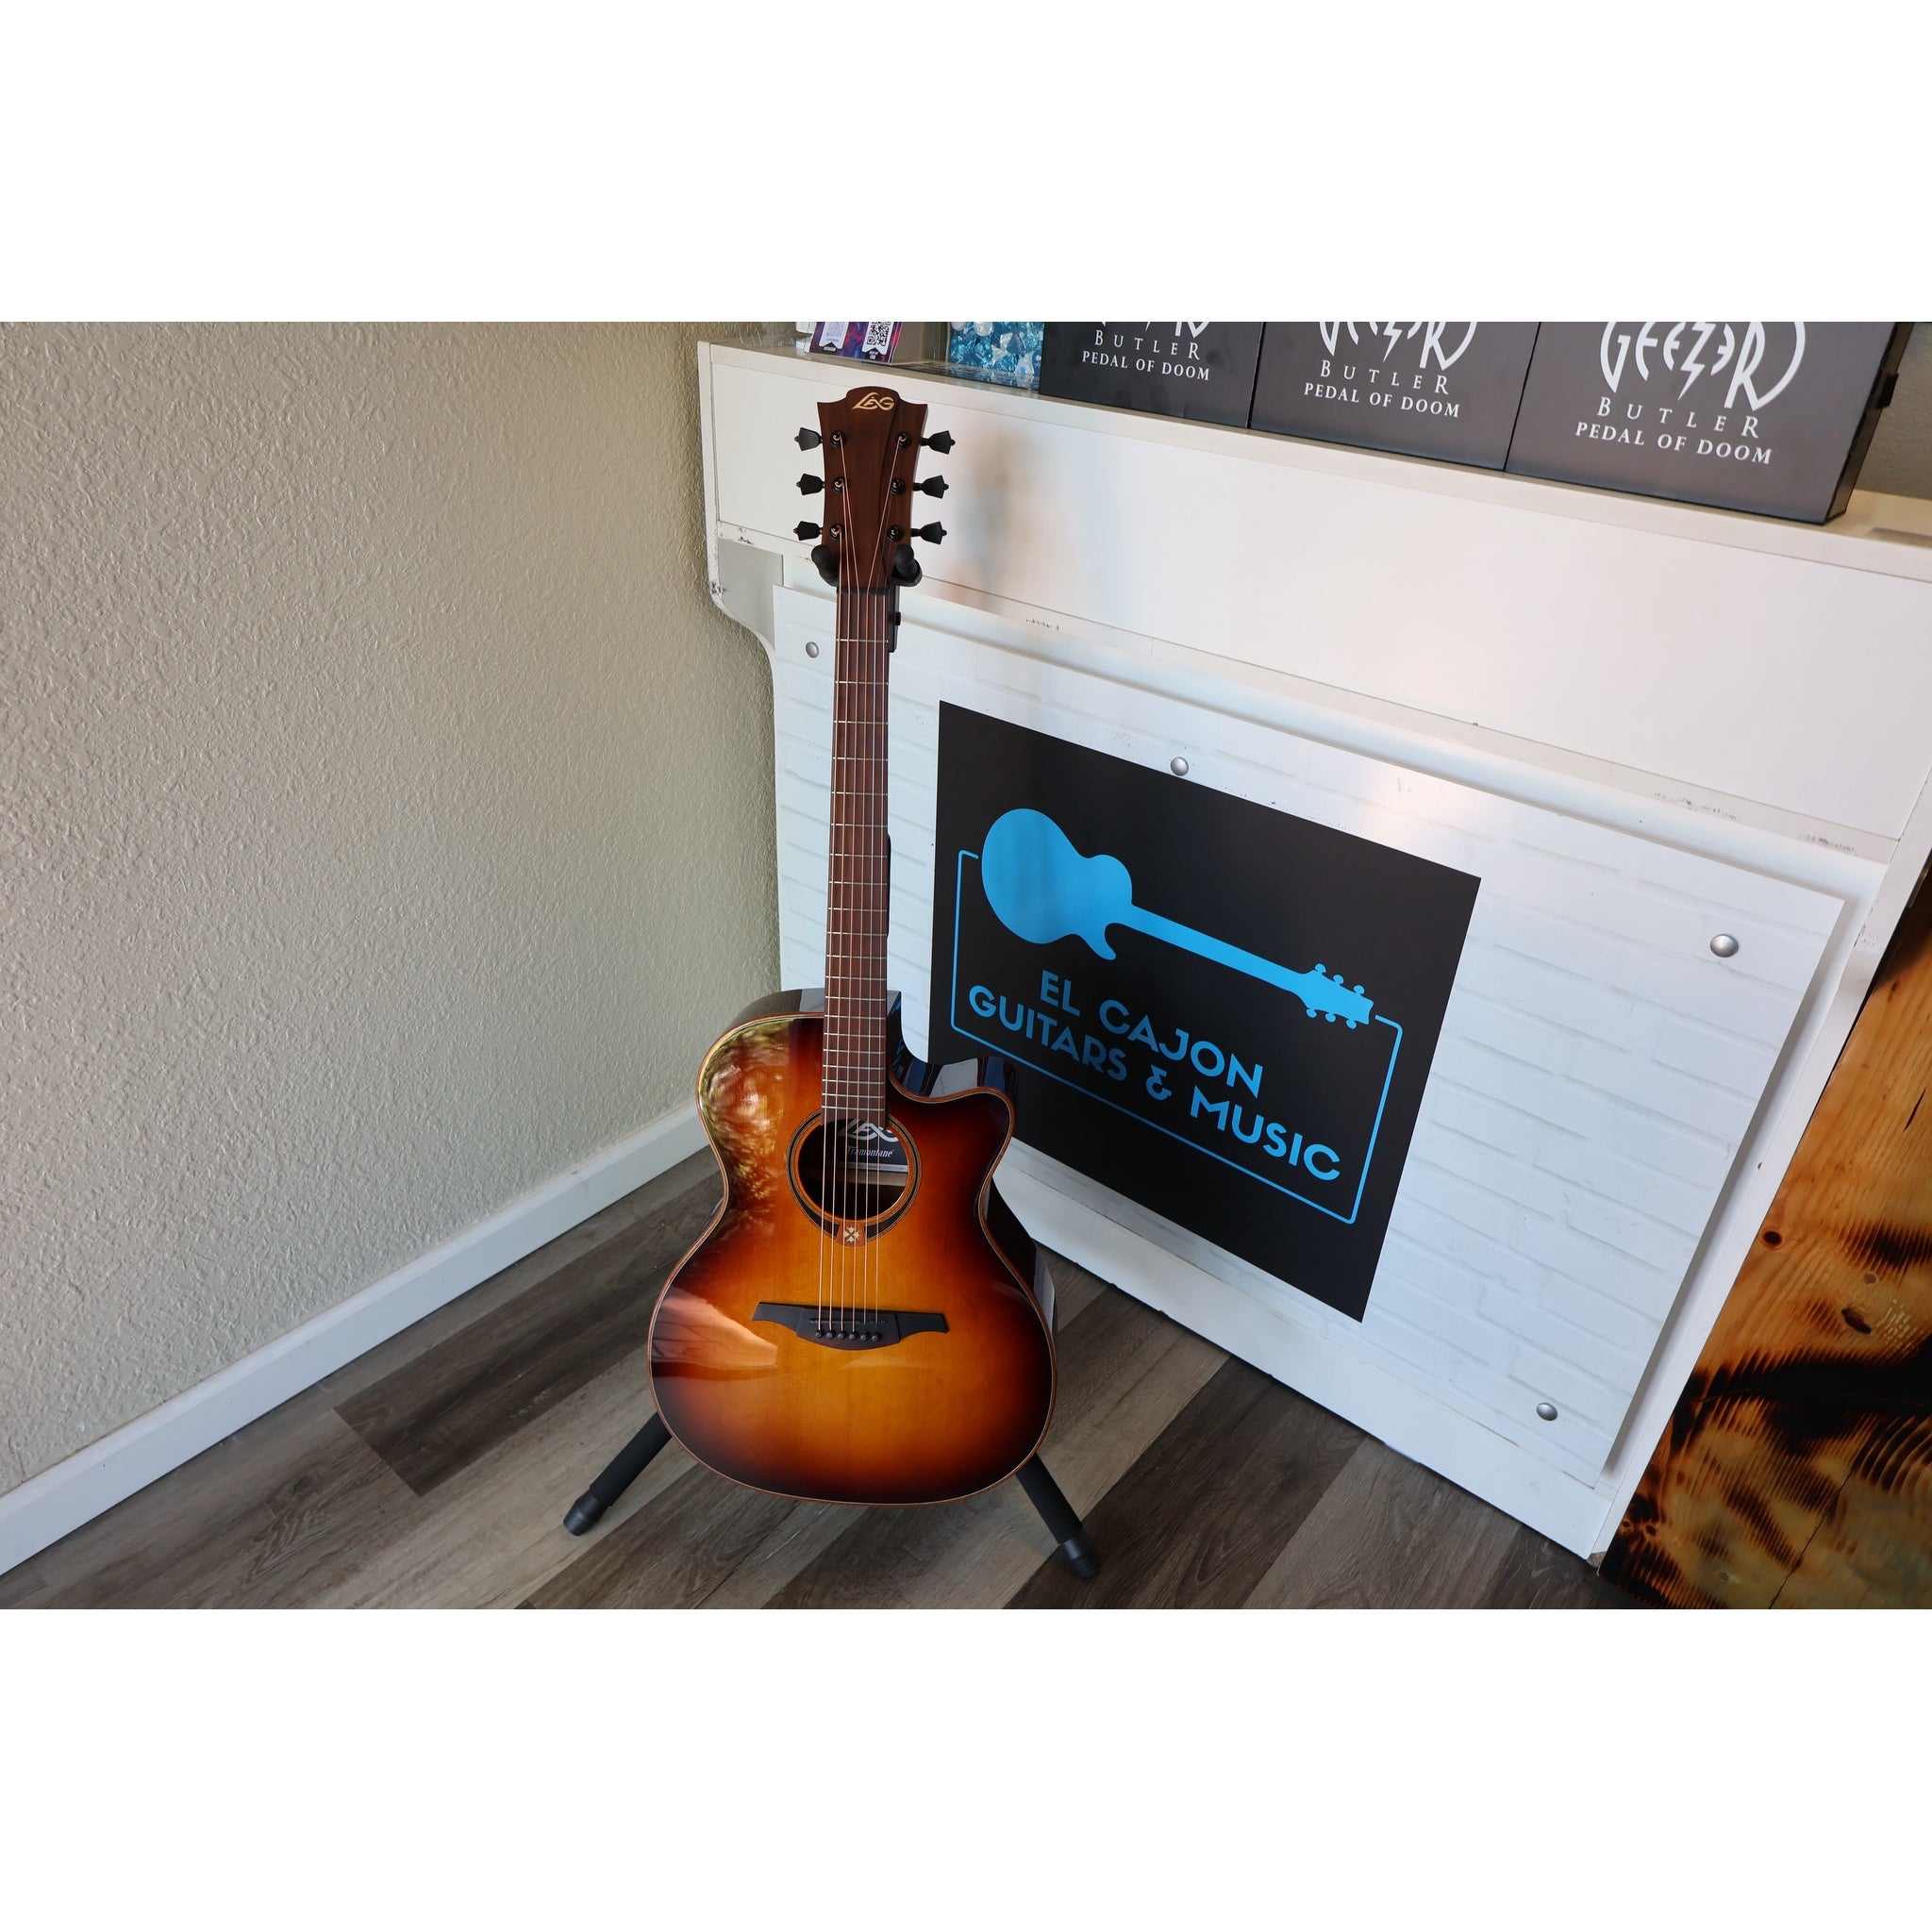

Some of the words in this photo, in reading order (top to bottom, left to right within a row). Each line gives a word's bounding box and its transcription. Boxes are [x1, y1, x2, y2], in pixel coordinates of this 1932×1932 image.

[1094, 329, 1200, 360] BUTLER
[1082, 350, 1128, 369] PEDAL
[1136, 358, 1155, 373] OF
[1161, 361, 1209, 381] DOOM
[1321, 359, 1449, 395] BUTLER
[1304, 382, 1359, 403] PEDAL
[1369, 391, 1392, 408] OF
[1400, 396, 1460, 418] DOOM
[1597, 396, 1759, 438] BUTLER
[1575, 422, 1644, 445] PEDAL
[1657, 434, 1687, 452] OF
[1697, 440, 1772, 464] DOOM
[1040, 970, 1080, 1017] EL
[1099, 999, 1264, 1099] CAJON
[969, 985, 1127, 1081] GUITARS
[1145, 1064, 1172, 1101] &
[1190, 1085, 1341, 1181] MUSIC
